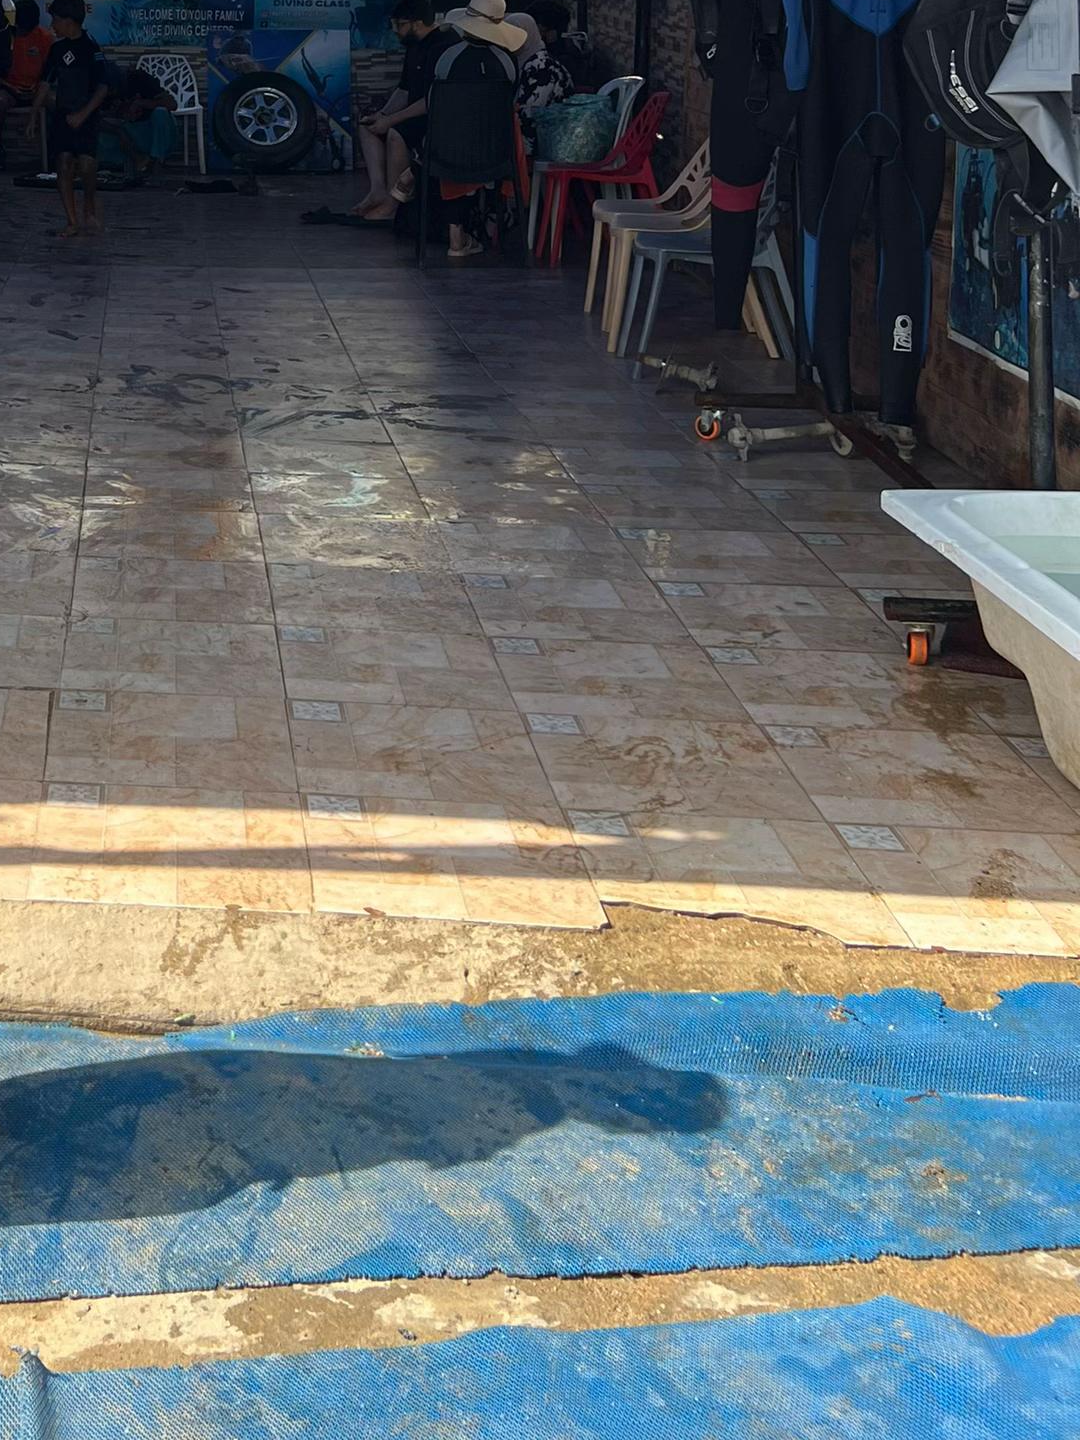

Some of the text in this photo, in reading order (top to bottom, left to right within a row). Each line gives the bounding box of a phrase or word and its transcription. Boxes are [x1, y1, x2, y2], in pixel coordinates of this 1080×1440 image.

[273, 0, 351, 8] DIVING CLASS
[128, 8, 245, 22] WELCOME TO YOUR FAMILY
[164, 24, 193, 36] DIVING
